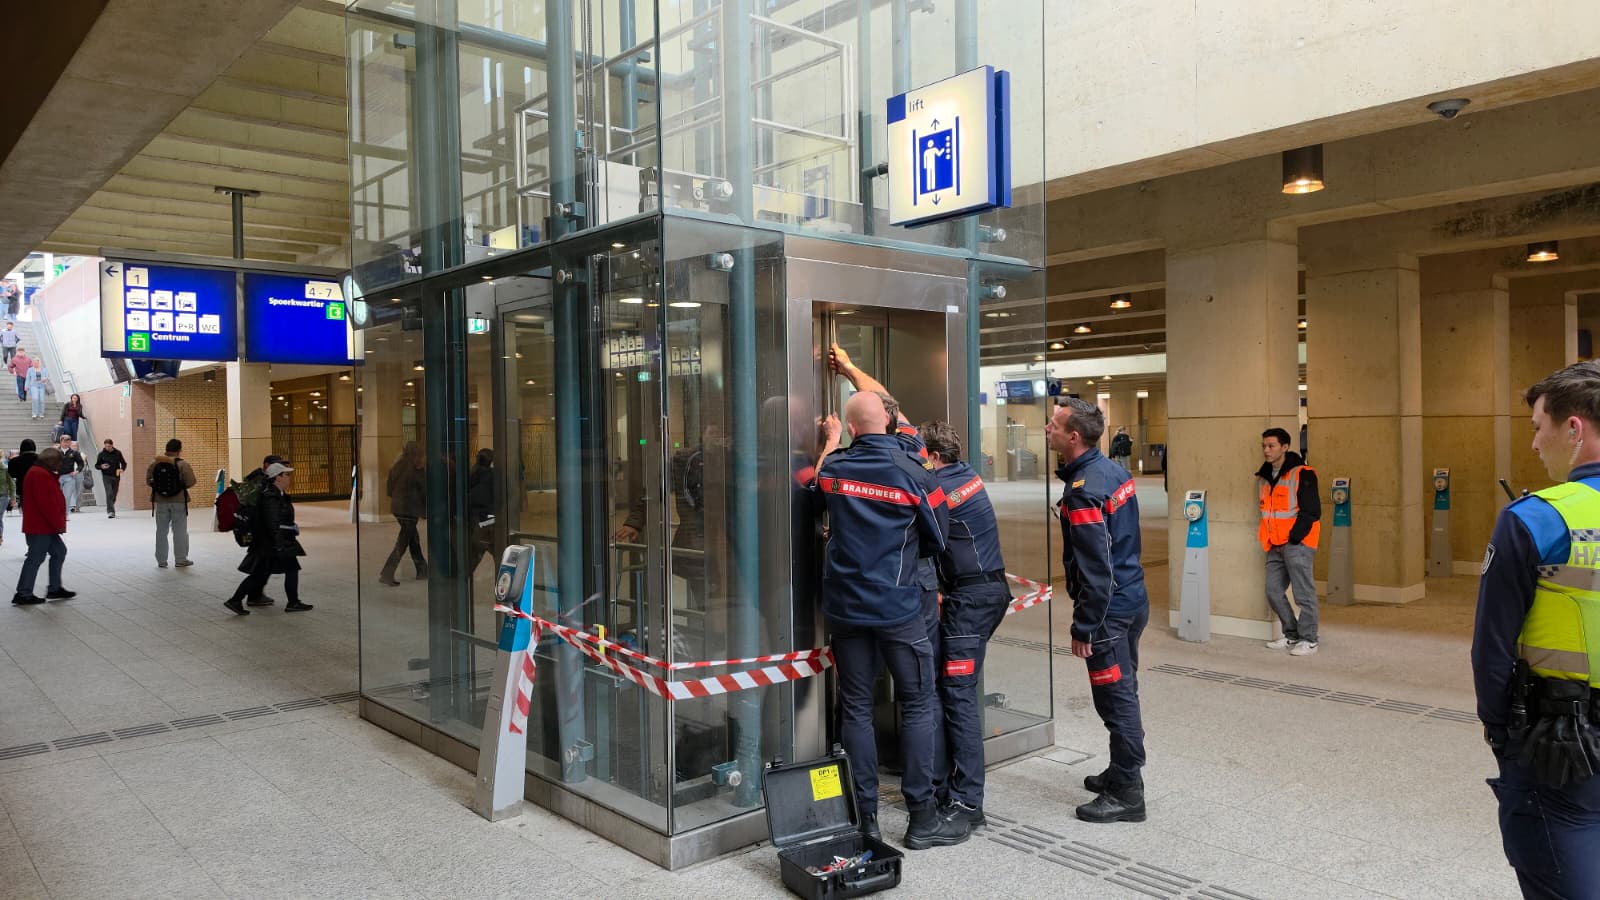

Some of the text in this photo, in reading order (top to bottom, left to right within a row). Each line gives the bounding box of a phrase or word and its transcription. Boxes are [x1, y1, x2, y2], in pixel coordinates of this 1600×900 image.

[909, 98, 924, 112] lift
[134, 274, 140, 284] 1
[326, 288, 332, 297] 7
[268, 298, 325, 307] Spoorkwartier
[201, 324, 217, 332] WC
[152, 333, 190, 341] Centrum
[842, 484, 901, 500] BRANDWEER
